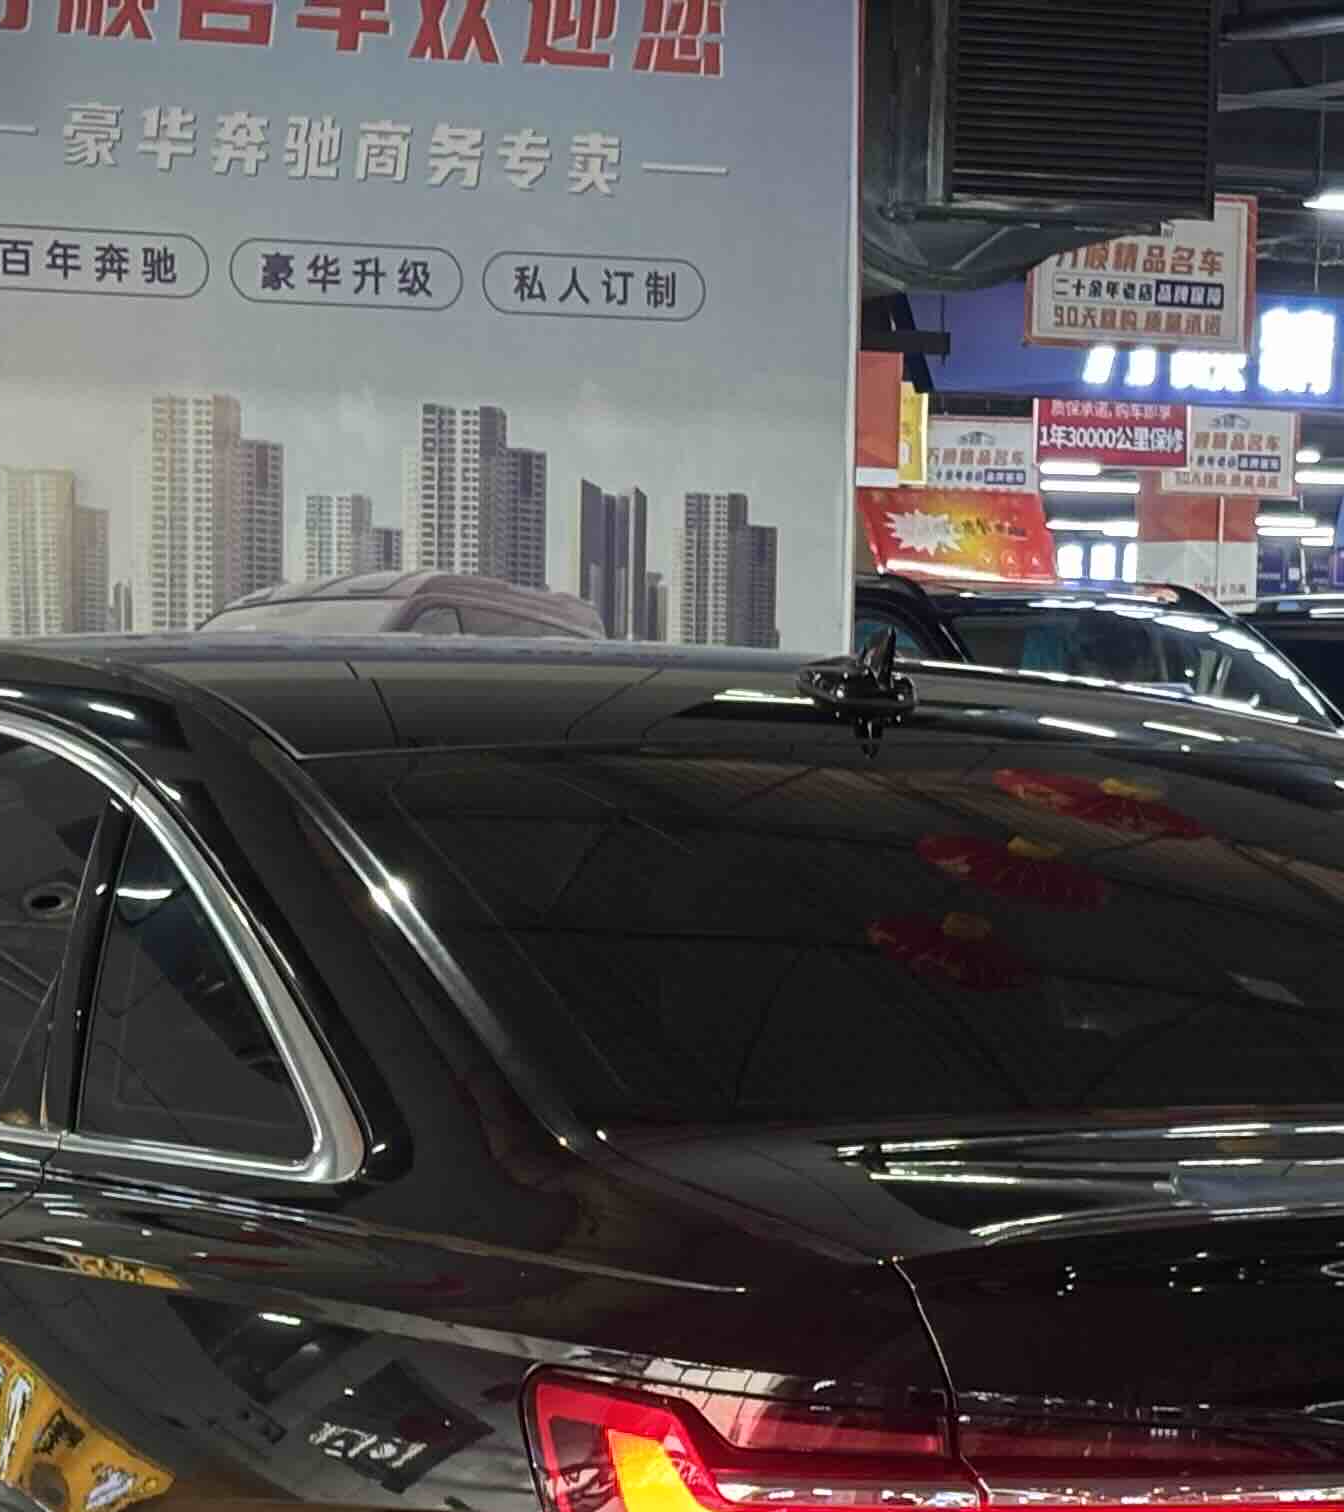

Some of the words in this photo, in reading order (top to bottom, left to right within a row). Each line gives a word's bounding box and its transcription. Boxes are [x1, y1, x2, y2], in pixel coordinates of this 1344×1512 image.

[61, 101, 624, 195] 豪华奔驰商务专卖
[259, 251, 435, 300] 豪华升级
[512, 264, 679, 310] 私人订制
[1039, 425, 1185, 453] 1年30000公里保修
